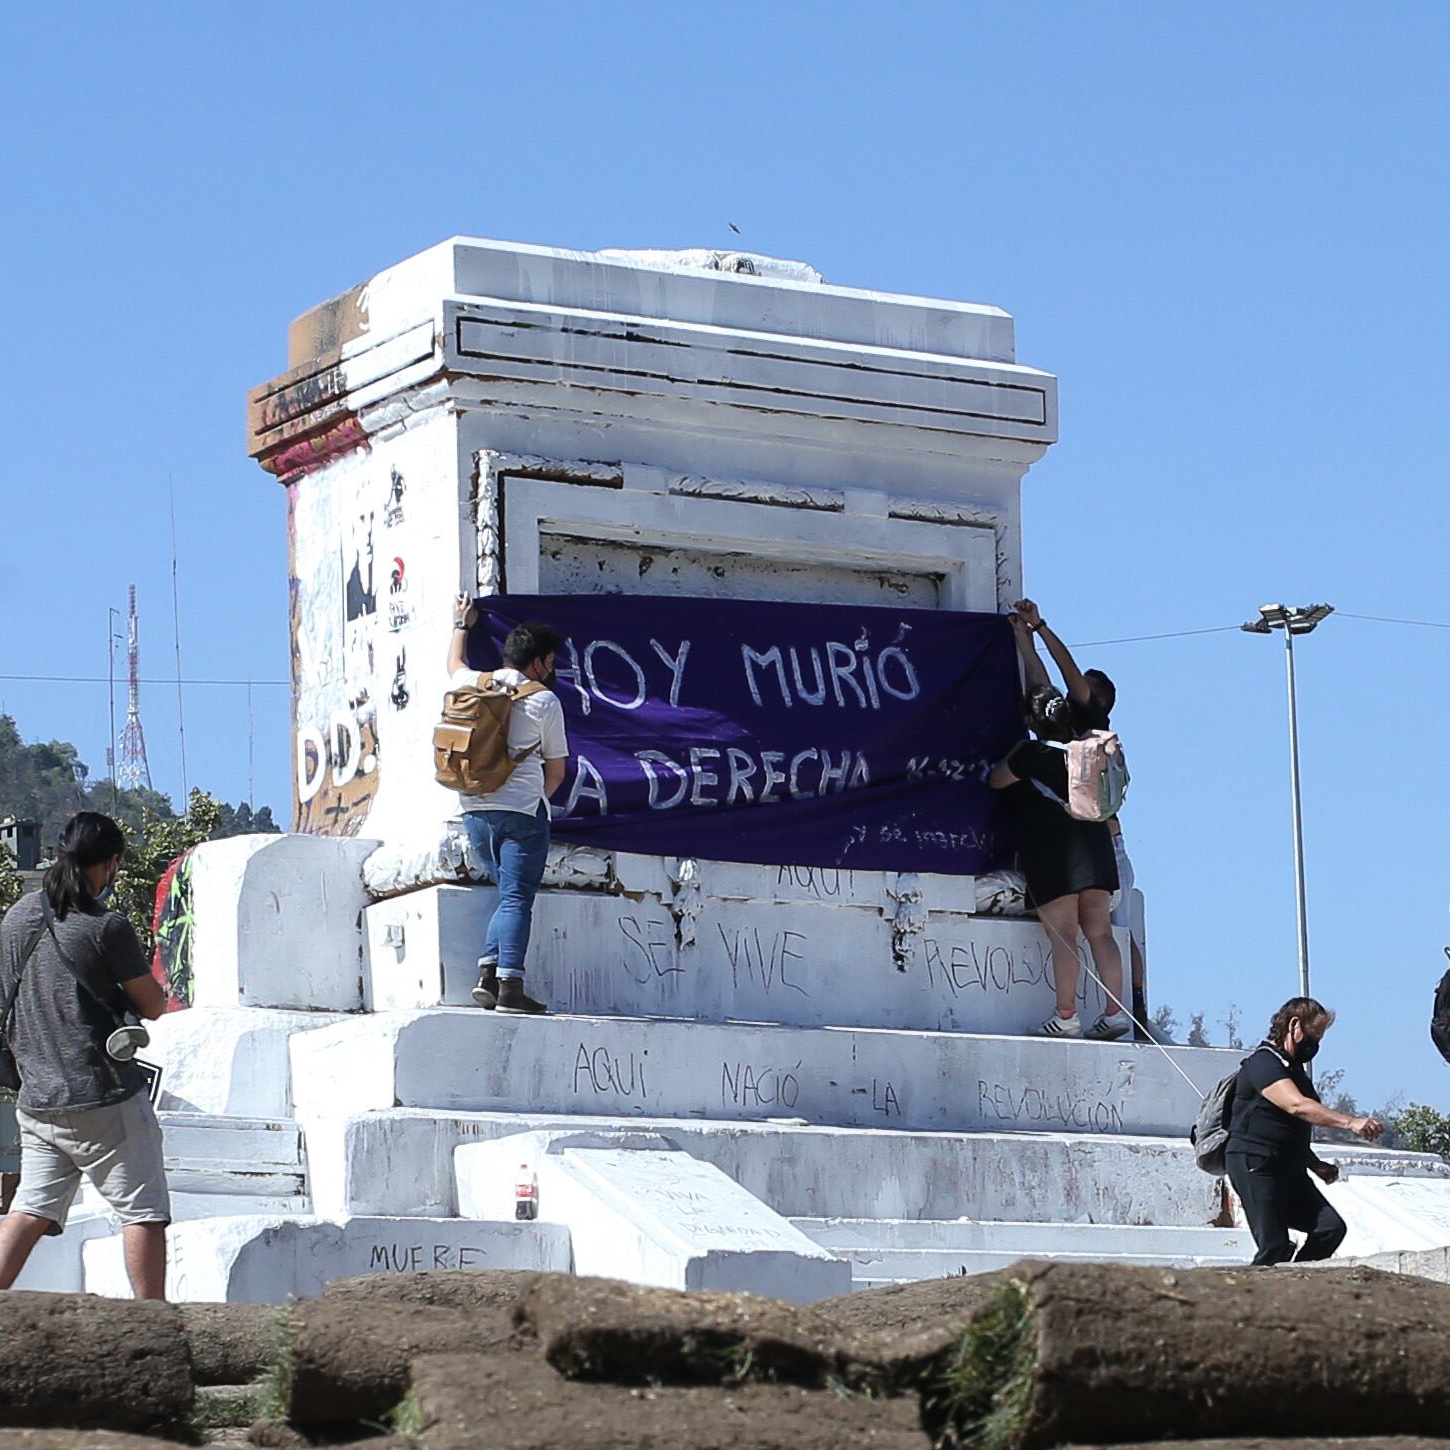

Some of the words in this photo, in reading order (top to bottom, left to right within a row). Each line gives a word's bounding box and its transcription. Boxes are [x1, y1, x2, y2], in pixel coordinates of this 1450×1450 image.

[555, 637, 691, 715] HOY
[635, 747, 871, 811] DERECHA
[618, 914, 686, 984] SE
[721, 1060, 802, 1109] NACIÓ
[872, 1078, 901, 1117] LA
